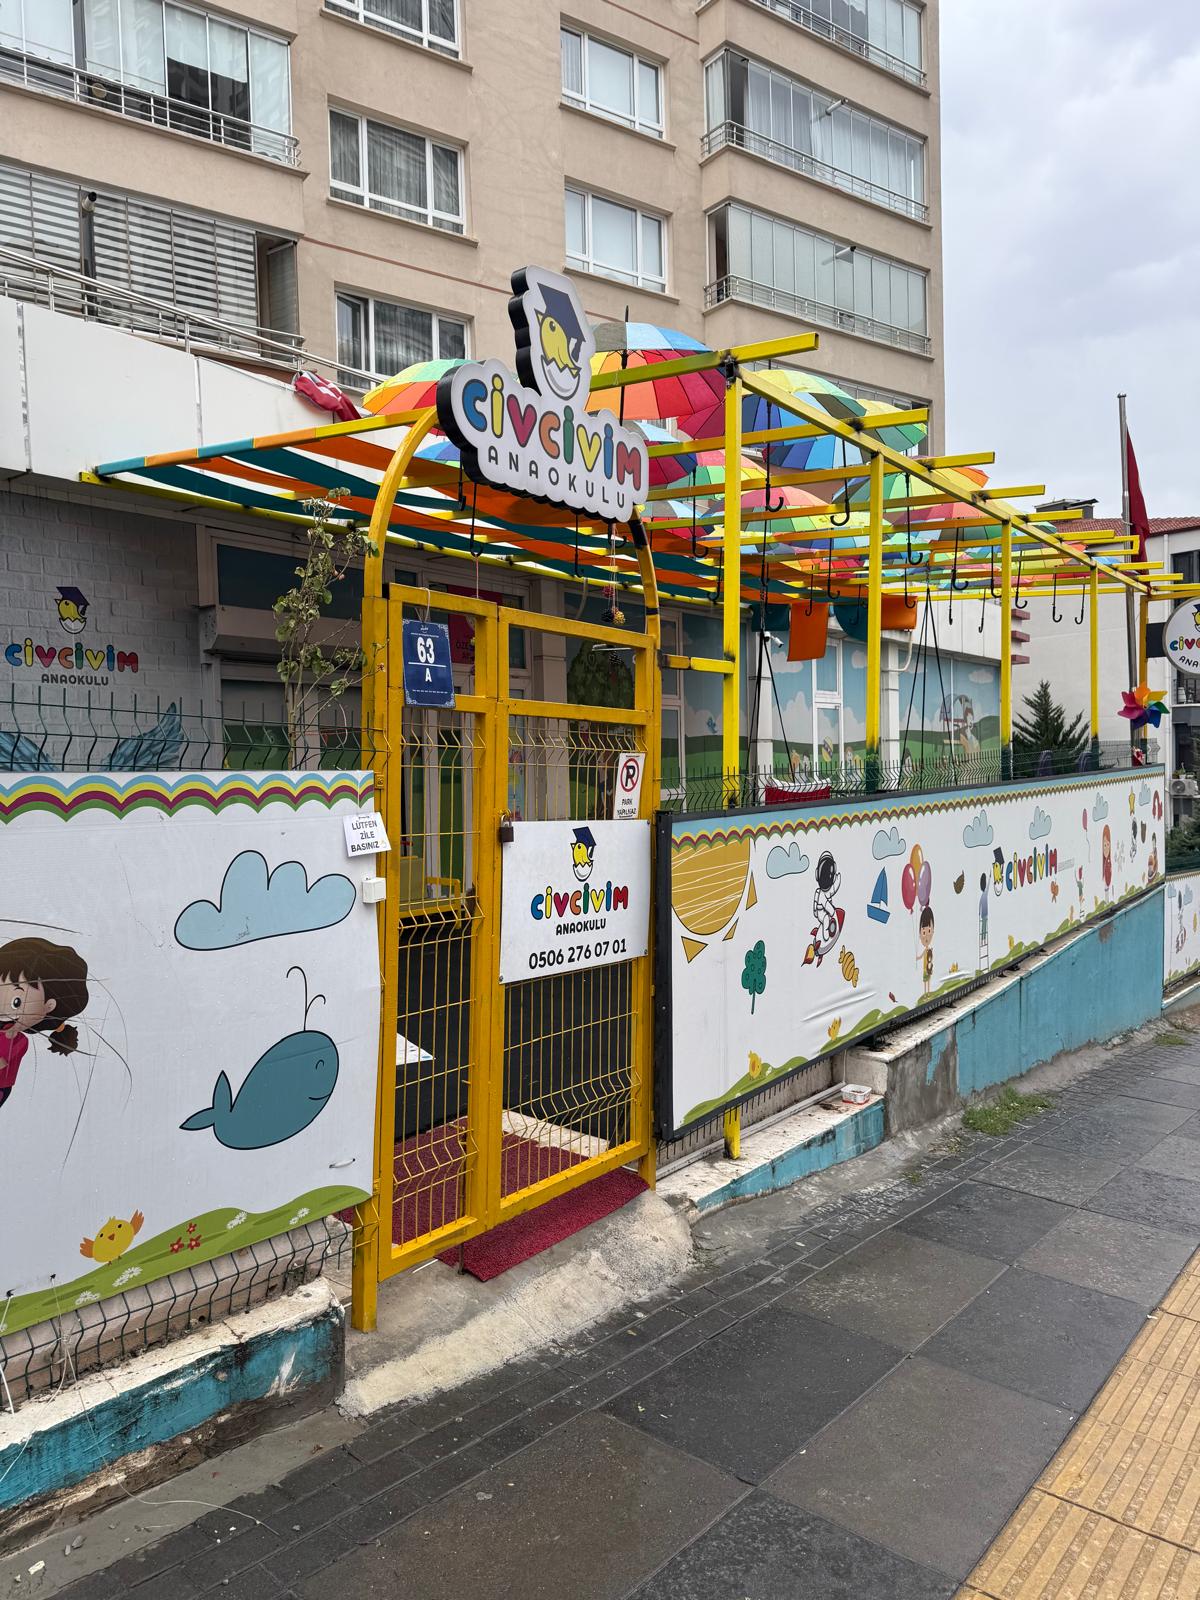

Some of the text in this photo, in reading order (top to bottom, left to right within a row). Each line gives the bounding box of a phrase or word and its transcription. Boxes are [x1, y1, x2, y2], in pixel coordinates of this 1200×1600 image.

[488, 445, 625, 508] ANAOKULU
[417, 636, 435, 664] 63
[41, 673, 109, 686] ANAOKULU
[425, 667, 433, 683] A
[621, 798, 633, 806] PARK
[351, 820, 378, 831] LÜTFEN
[359, 830, 375, 840] ZİLE
[350, 841, 380, 853] BASINIZ
[555, 918, 607, 936] ANAOKULU
[528, 938, 627, 970] 0506 276 07 01
